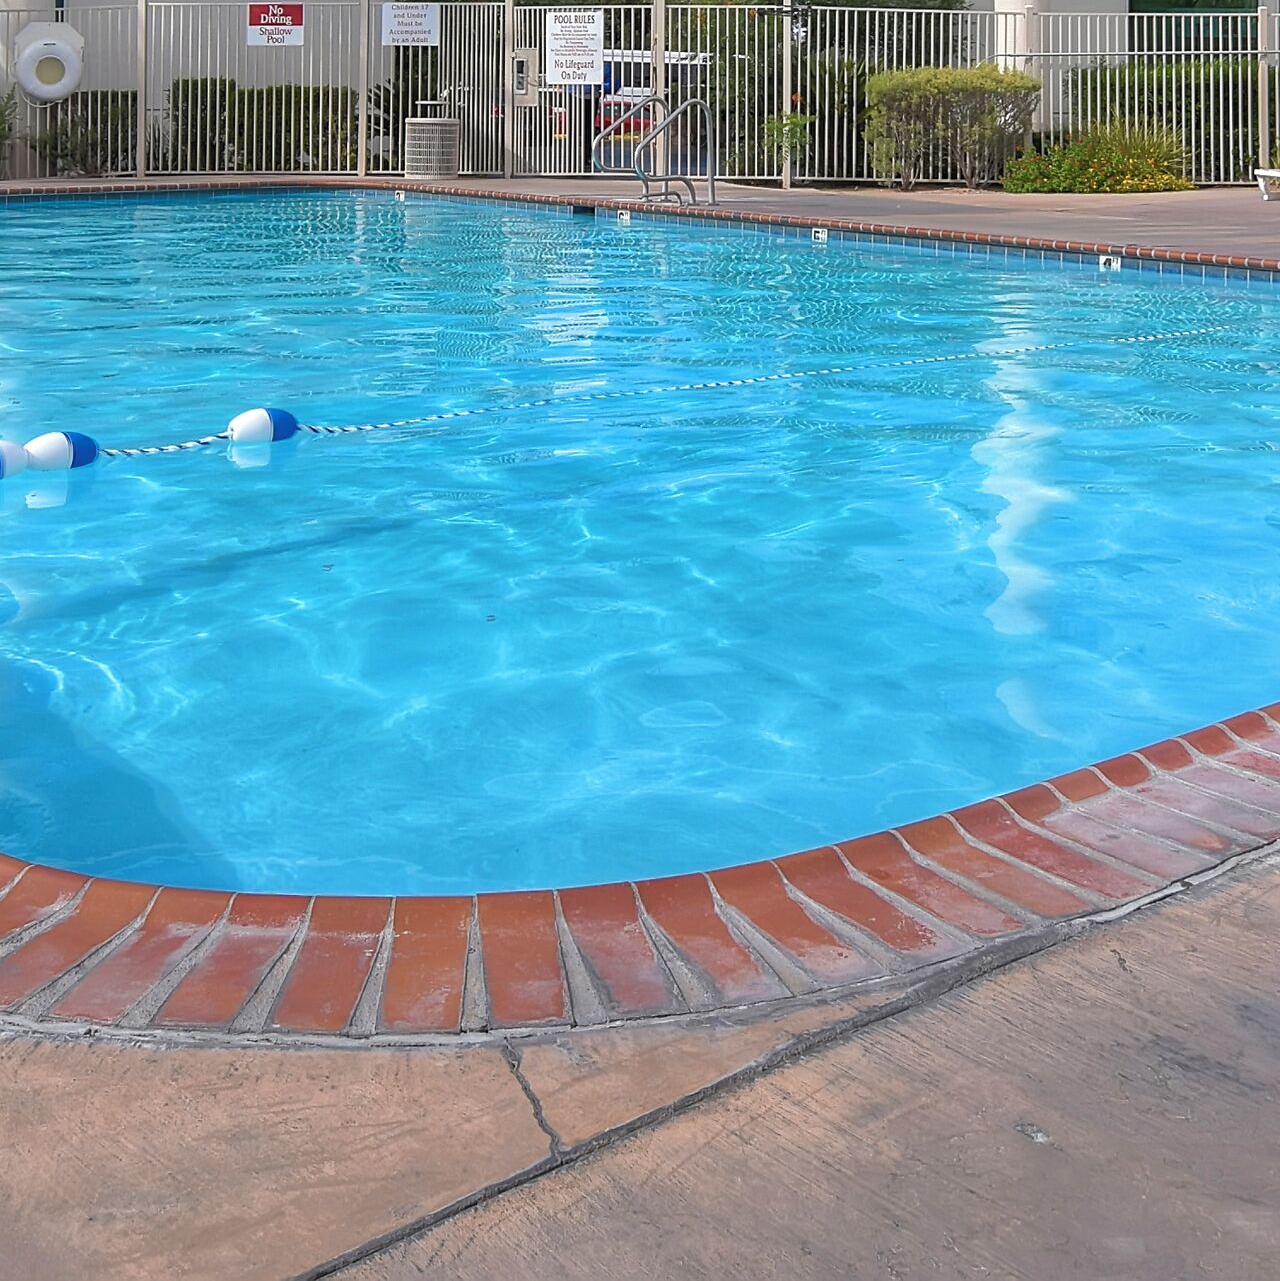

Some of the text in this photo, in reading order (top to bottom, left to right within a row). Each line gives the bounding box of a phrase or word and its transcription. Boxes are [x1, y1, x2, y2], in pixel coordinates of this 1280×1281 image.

[269, 5, 284, 16] No
[260, 14, 293, 26] Diving
[554, 15, 596, 24] POOL RULES
[259, 27, 293, 36] Shallow
[267, 35, 285, 44] Pool
[554, 59, 595, 71] No Lifeguard
[561, 71, 587, 82] On Duty
